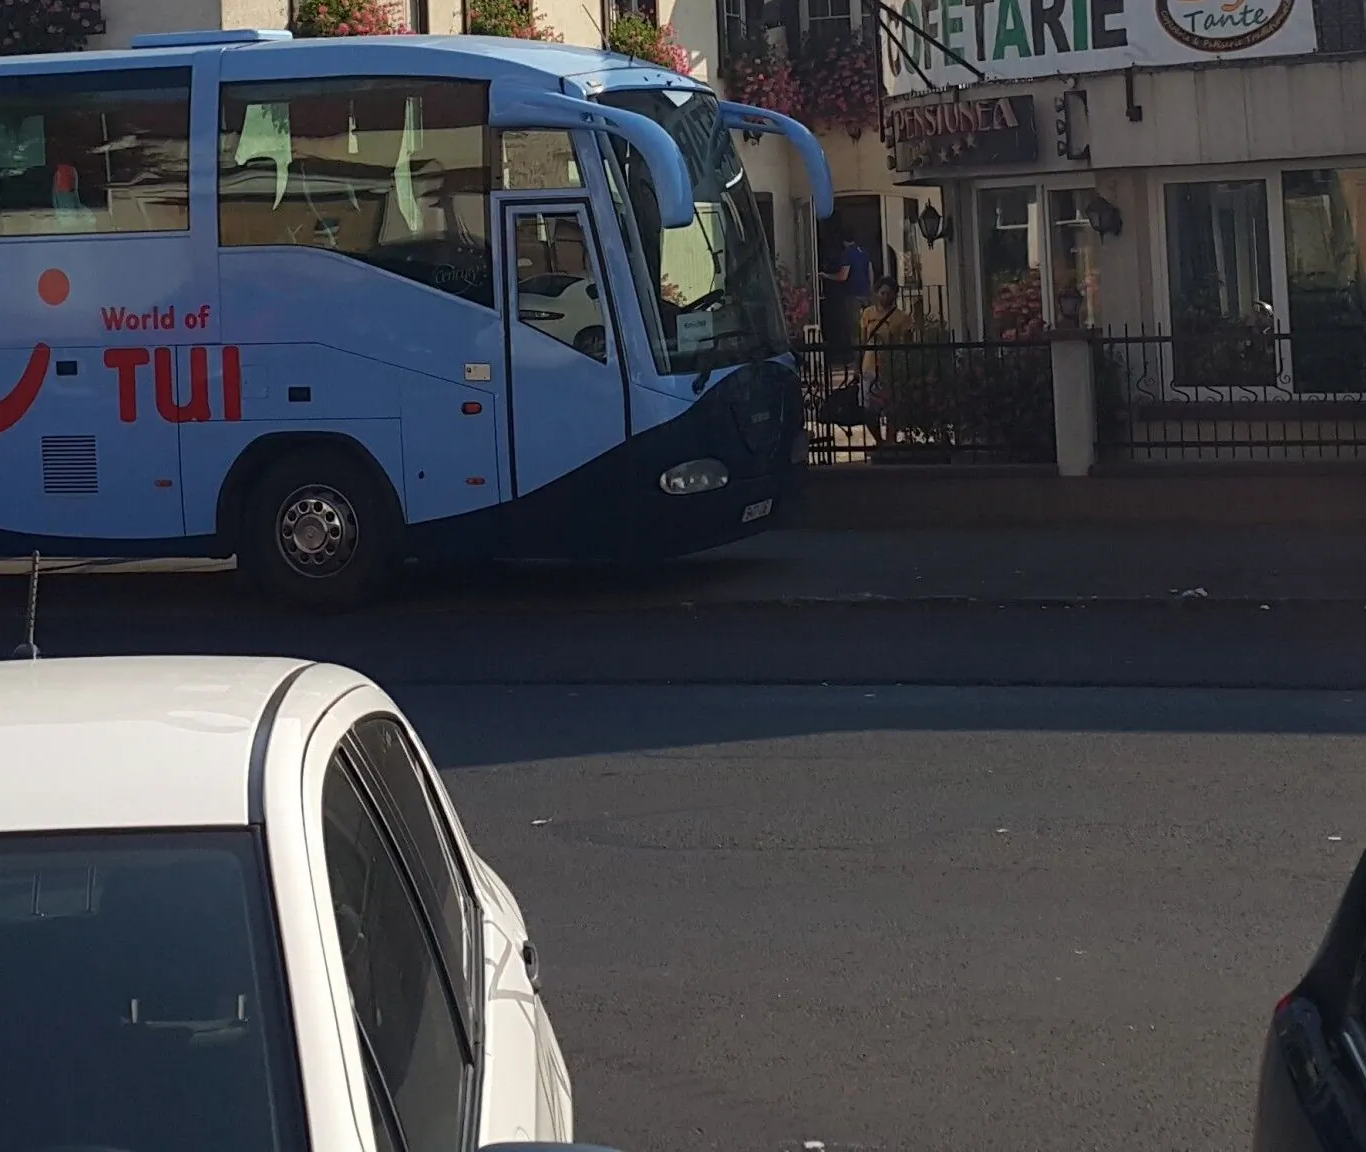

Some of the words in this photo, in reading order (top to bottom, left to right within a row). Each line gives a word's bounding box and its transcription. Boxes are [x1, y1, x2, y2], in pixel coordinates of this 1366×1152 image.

[1183, 5, 1269, 33] Tante
[894, 97, 1019, 141] PENSIUNEA
[100, 305, 175, 331] World
[183, 304, 211, 330] of
[103, 345, 242, 423] TUI
